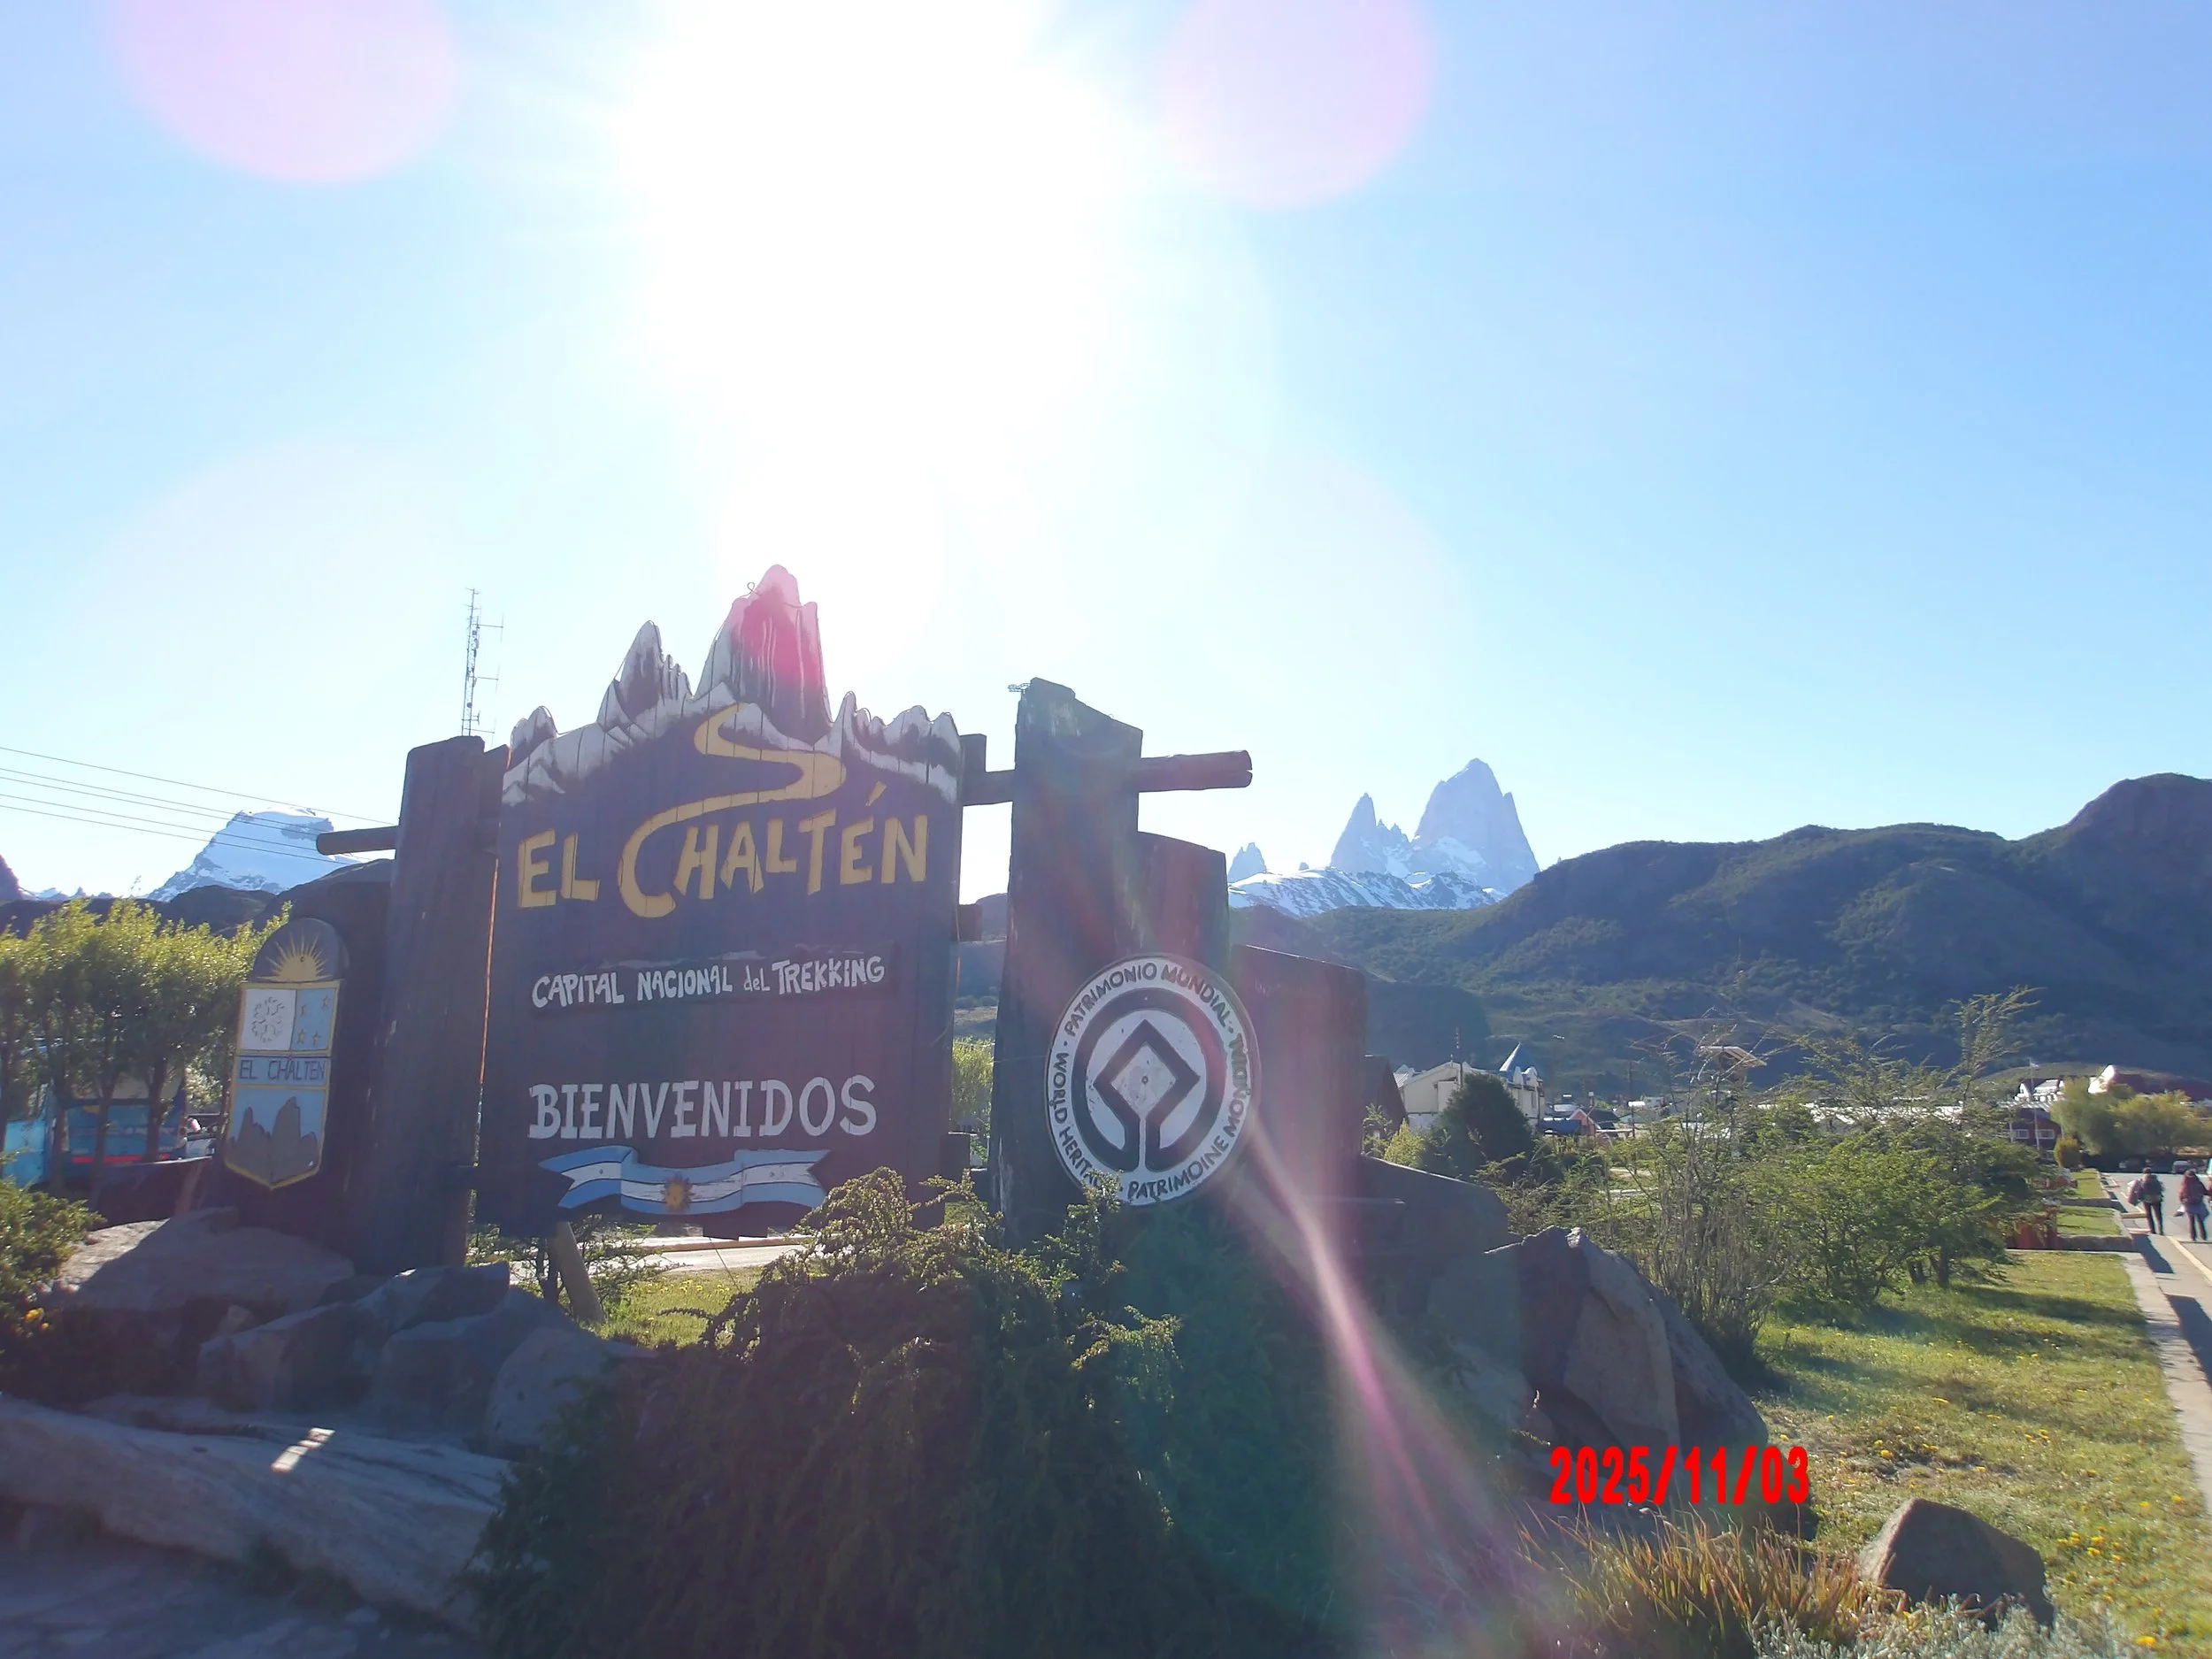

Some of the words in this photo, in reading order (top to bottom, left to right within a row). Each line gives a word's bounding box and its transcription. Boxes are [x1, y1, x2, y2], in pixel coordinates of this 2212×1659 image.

[518, 828, 600, 908] EL
[619, 780, 929, 918] CHALTÉN
[532, 972, 625, 1008] CAPITAL
[637, 964, 733, 1002] NACIONAL
[772, 956, 885, 995] TREKKING
[1064, 963, 1157, 1037] PATRIMONIO
[1161, 964, 1233, 1028] MUNDIAL
[240, 1060, 258, 1079] EL
[1053, 1052, 1070, 1124] WORLD
[528, 1075, 877, 1139] BIENVENIDOS
[1059, 1126, 1103, 1190] HERITA
[1127, 1135, 1229, 1200] PATRIMOINE
